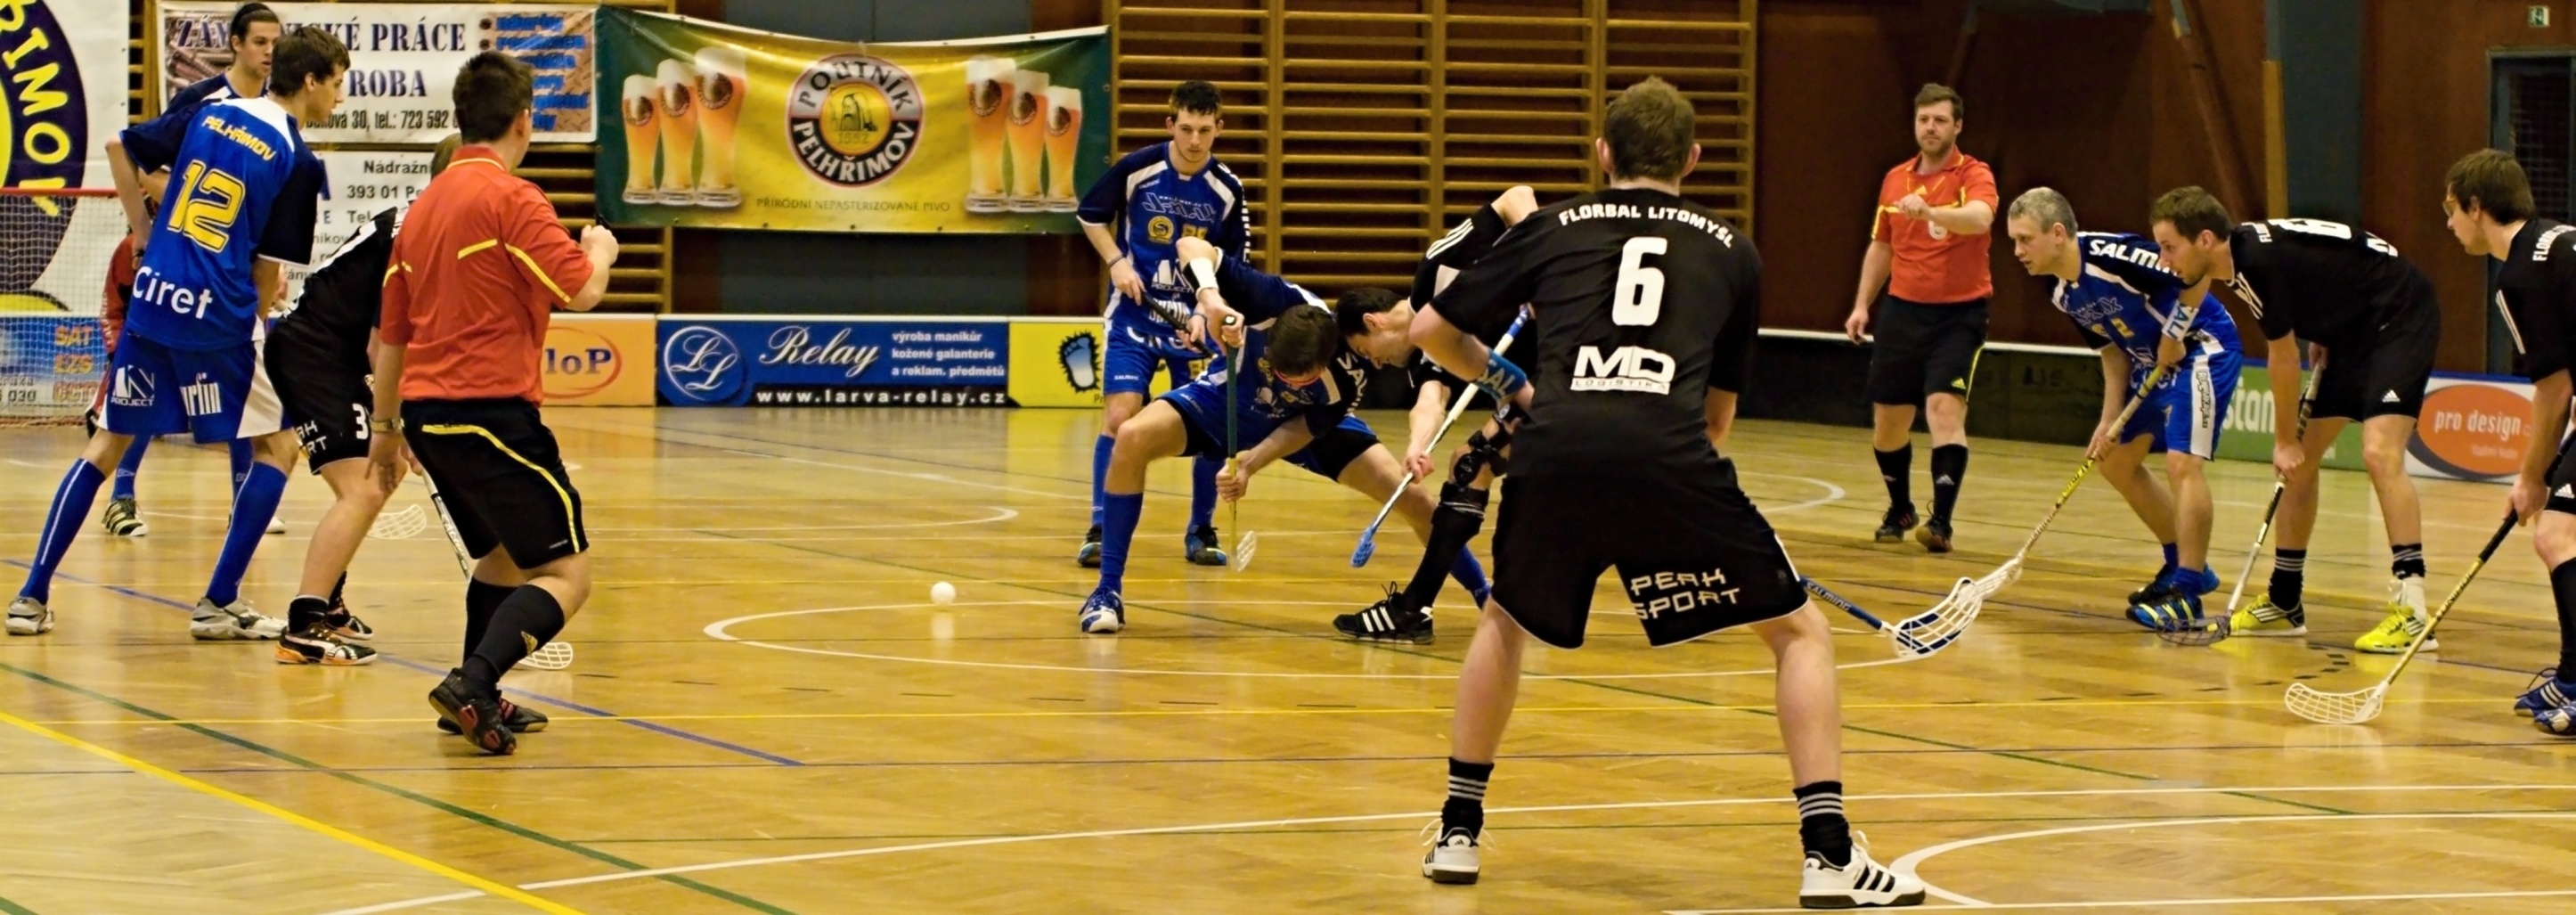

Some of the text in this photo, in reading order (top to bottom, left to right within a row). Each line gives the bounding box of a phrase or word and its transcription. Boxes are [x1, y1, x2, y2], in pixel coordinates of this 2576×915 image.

[371, 16, 466, 52] PRÁCE
[348, 69, 428, 97] ROBA
[401, 110, 422, 129] 723
[427, 110, 449, 129] 592
[201, 116, 276, 161] PELHŘIMOV
[793, 120, 915, 183] PELHŘIMOV
[363, 159, 432, 174] Nádražn
[167, 159, 246, 253] 12
[347, 185, 375, 199] 393
[380, 185, 399, 199] 01
[923, 201, 950, 212] PIVO
[1559, 203, 1642, 226] FLORBAL
[133, 266, 213, 320] Ciret
[1611, 236, 1668, 326] 6
[55, 325, 94, 347] SAT
[893, 331, 932, 344] výroba
[759, 326, 879, 378] Relay
[892, 347, 996, 361] kožené galanterie
[1573, 345, 1675, 383] MD
[892, 367, 900, 375] a
[902, 365, 946, 376] reklam.
[110, 397, 154, 406] PROJECT
[757, 389, 1005, 406] www.larva-relay.cz
[2433, 409, 2463, 434] pro
[2467, 409, 2522, 441] design
[1633, 588, 1740, 619] SPORT
[1806, 581, 1852, 611] SALMING
